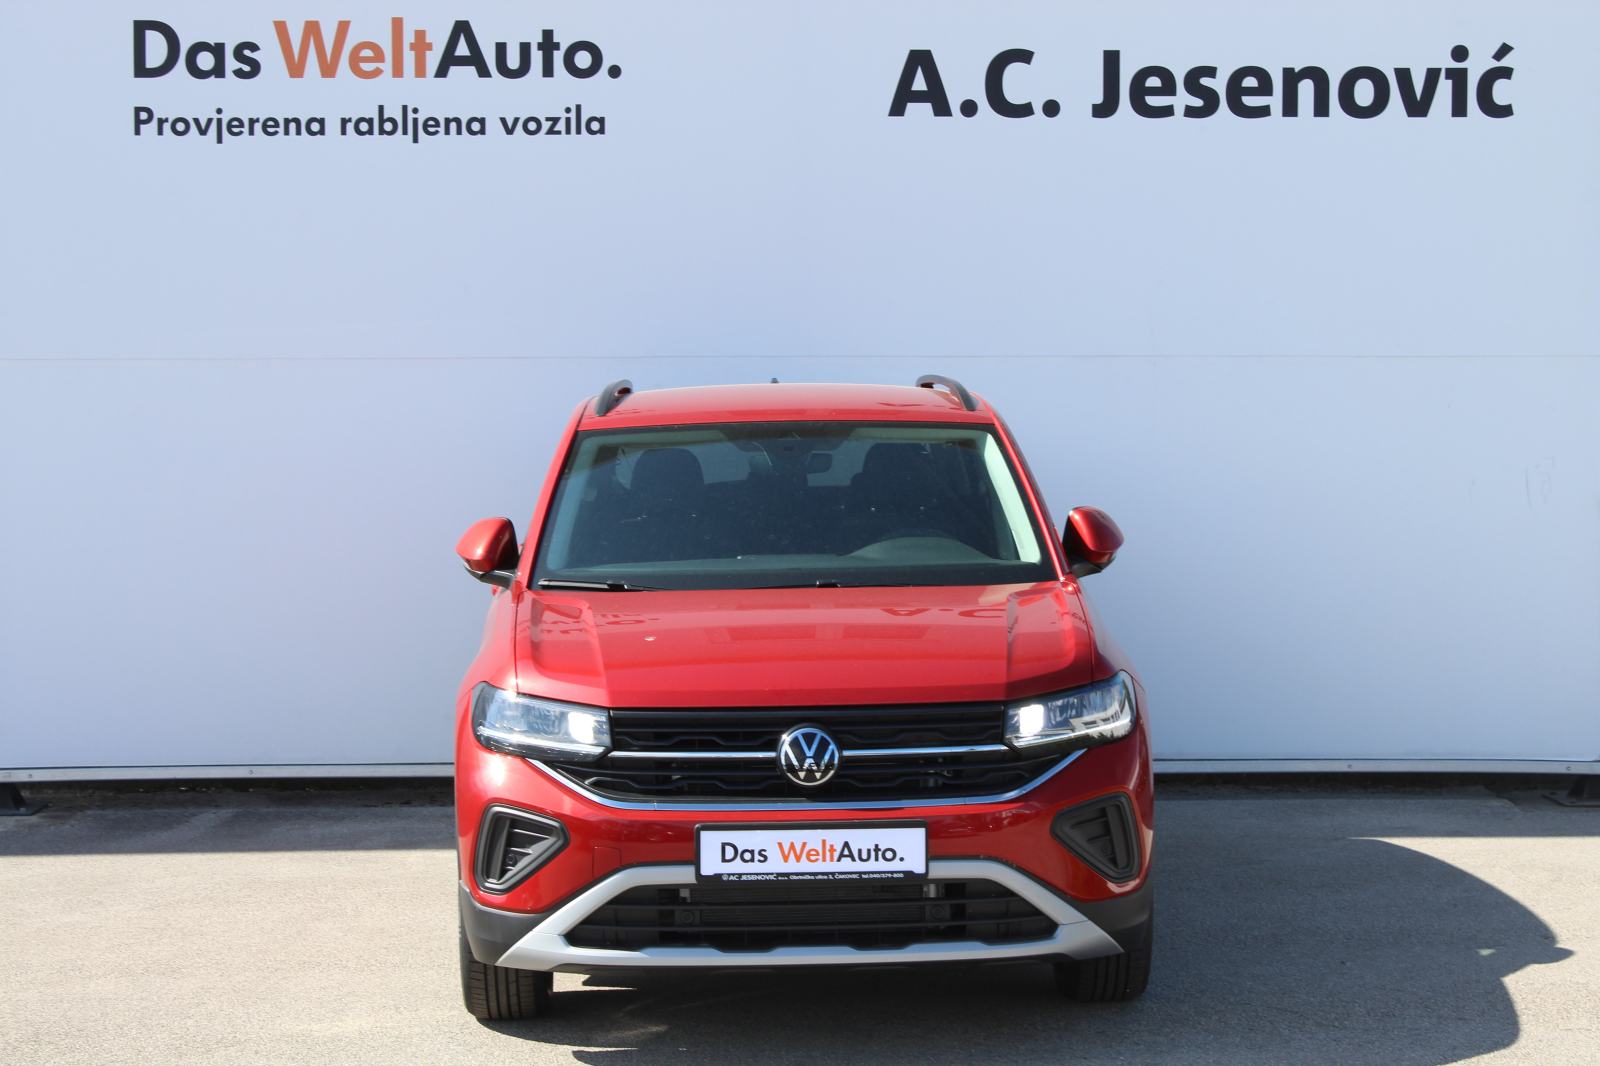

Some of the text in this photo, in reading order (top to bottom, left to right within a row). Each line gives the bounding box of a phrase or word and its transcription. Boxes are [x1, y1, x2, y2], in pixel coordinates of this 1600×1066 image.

[133, 17, 622, 80] Das WeltAuto.
[888, 42, 1515, 119] A.C. Jesenović
[134, 104, 605, 144] Provjerena rabljena vozila
[721, 839, 905, 864] Das WeltAuto.
